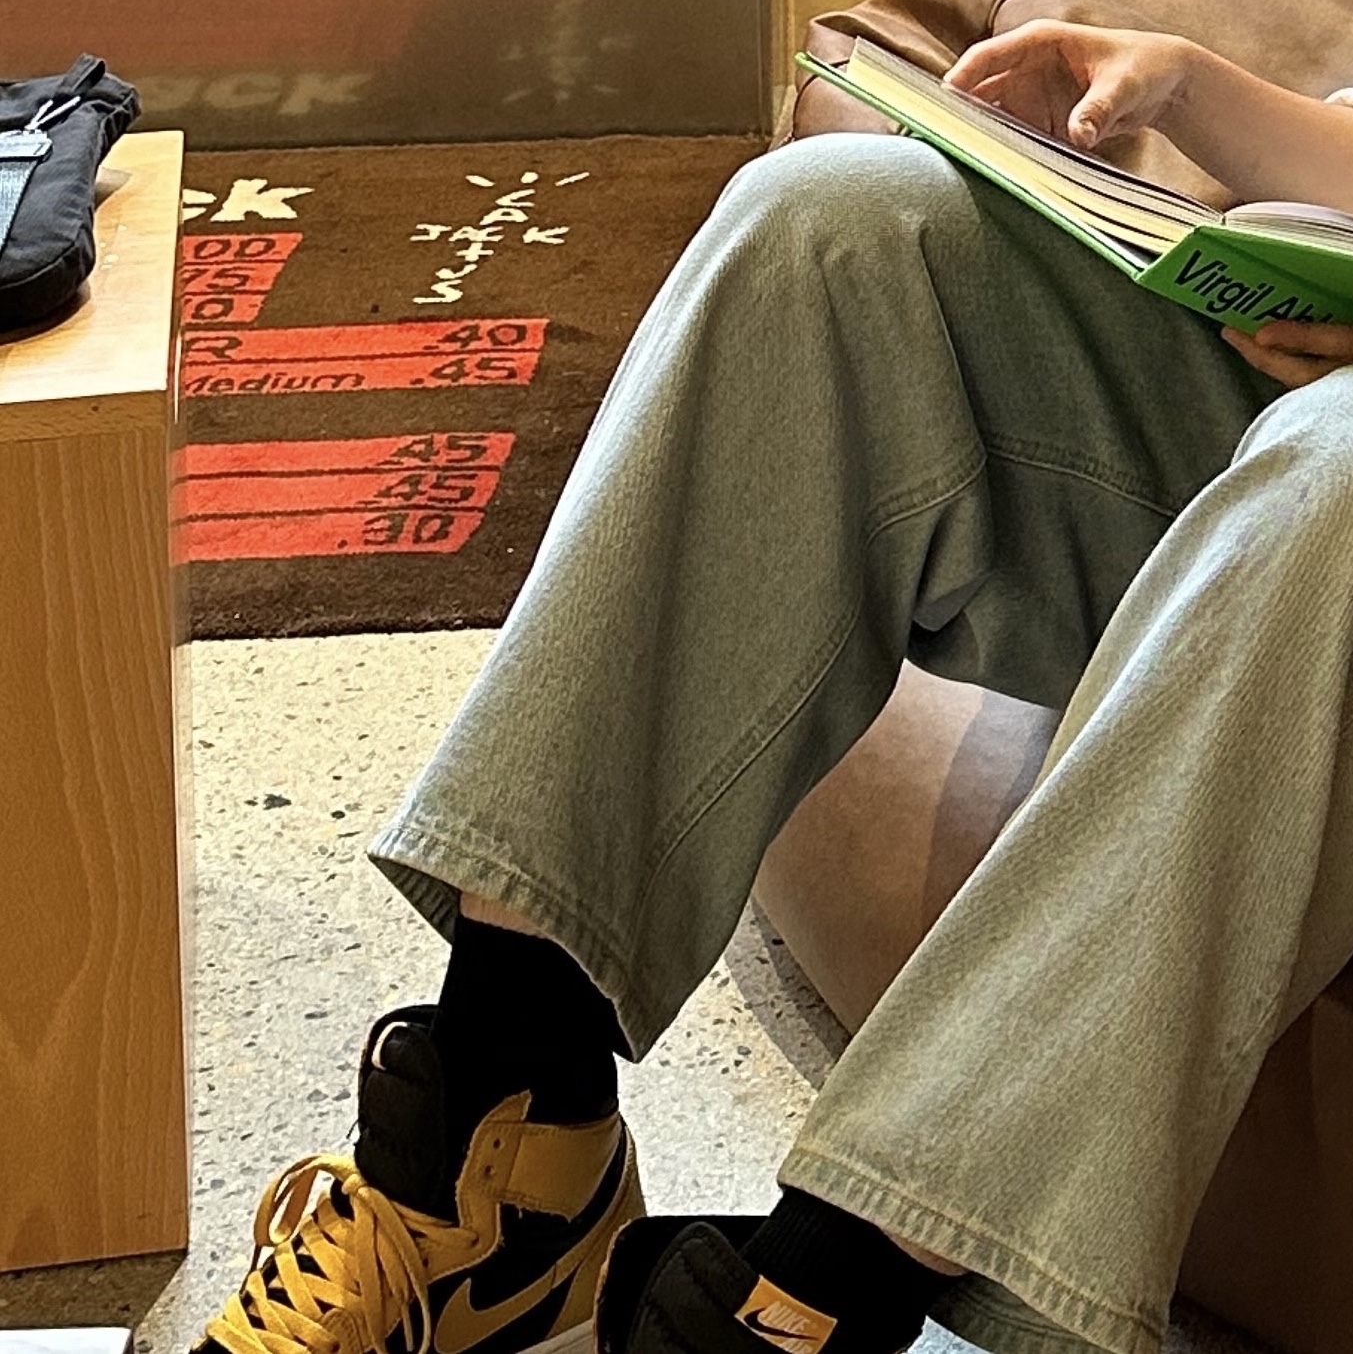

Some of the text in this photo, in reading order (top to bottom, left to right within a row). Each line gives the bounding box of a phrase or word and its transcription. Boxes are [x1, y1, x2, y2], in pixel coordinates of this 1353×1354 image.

[1174, 250, 1275, 314] Virgil
[184, 298, 234, 320] 0
[757, 1300, 812, 1332] NIKE
